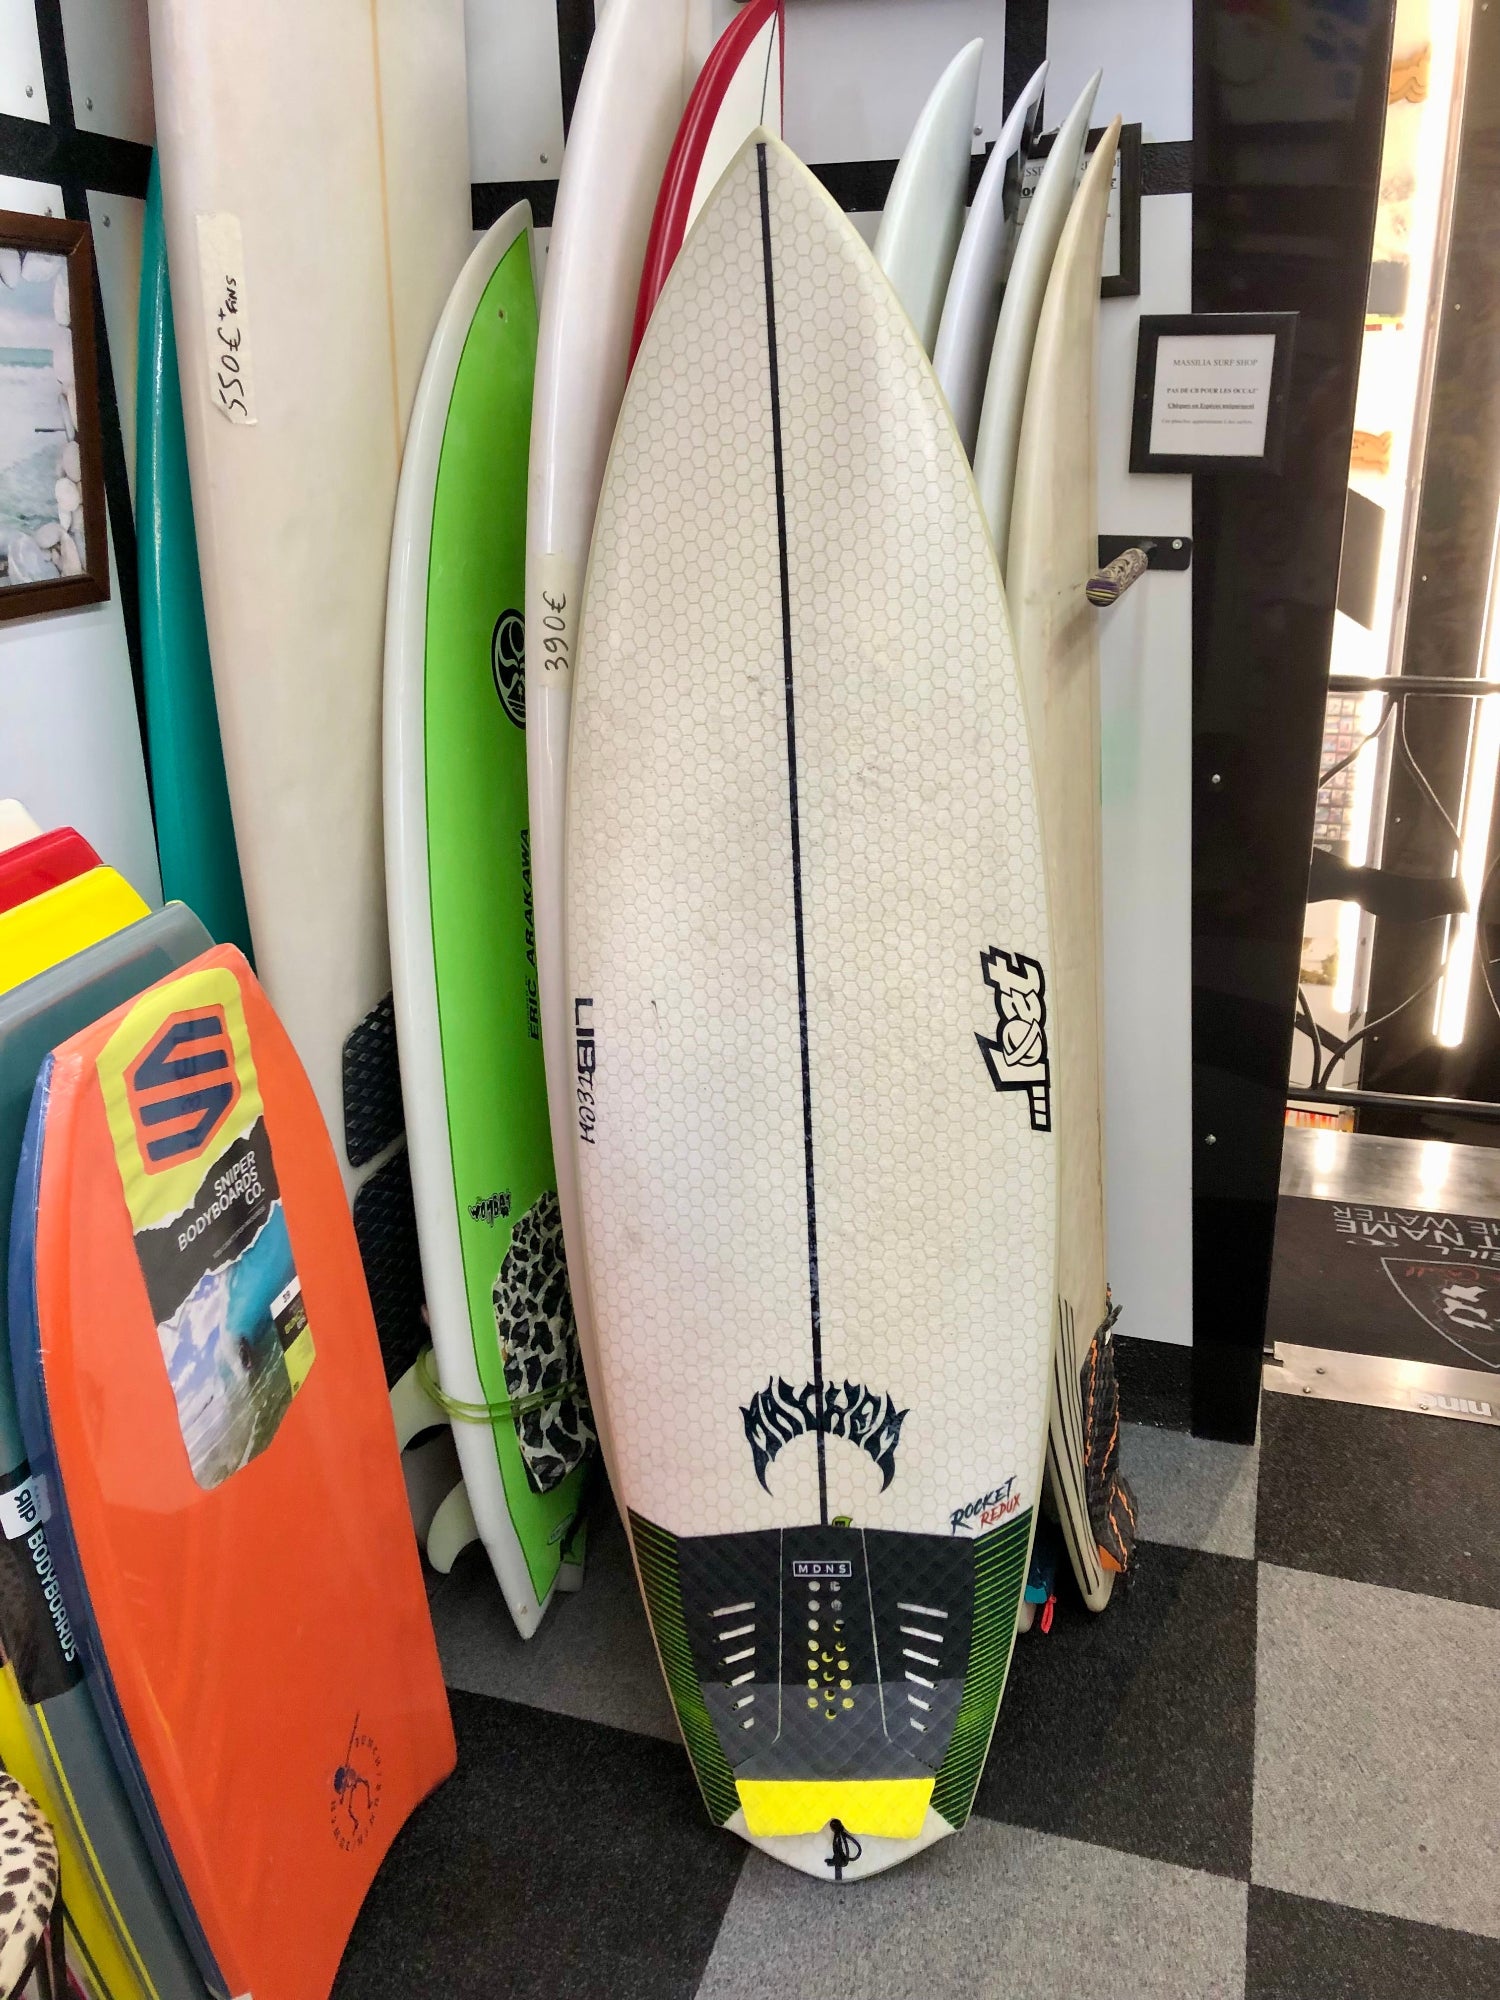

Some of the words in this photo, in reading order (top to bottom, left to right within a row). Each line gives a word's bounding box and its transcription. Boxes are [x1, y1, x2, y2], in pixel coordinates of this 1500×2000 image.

[216, 327, 248, 416] 550€
[1173, 359, 1211, 367] MASSILIA
[1213, 359, 1233, 367] SURF
[1236, 359, 1258, 367] SHOP
[542, 590, 569, 671] 390€
[520, 828, 537, 970] ARAKAWA
[527, 979, 540, 1041] ERIC
[214, 1150, 255, 1197] SNIPER
[245, 1181, 265, 1205] CO.
[178, 1165, 258, 1252] BODYBOARDS
[1332, 1205, 1460, 1233] WATER
[1335, 1219, 1465, 1247] NAME
[739, 1375, 910, 1497] MAYHEM
[950, 1475, 1017, 1536] ROCKET
[980, 1493, 1020, 1529] REDUX
[27, 1527, 75, 1662] BODYBOARDS
[798, 1563, 847, 1574] MDNS
